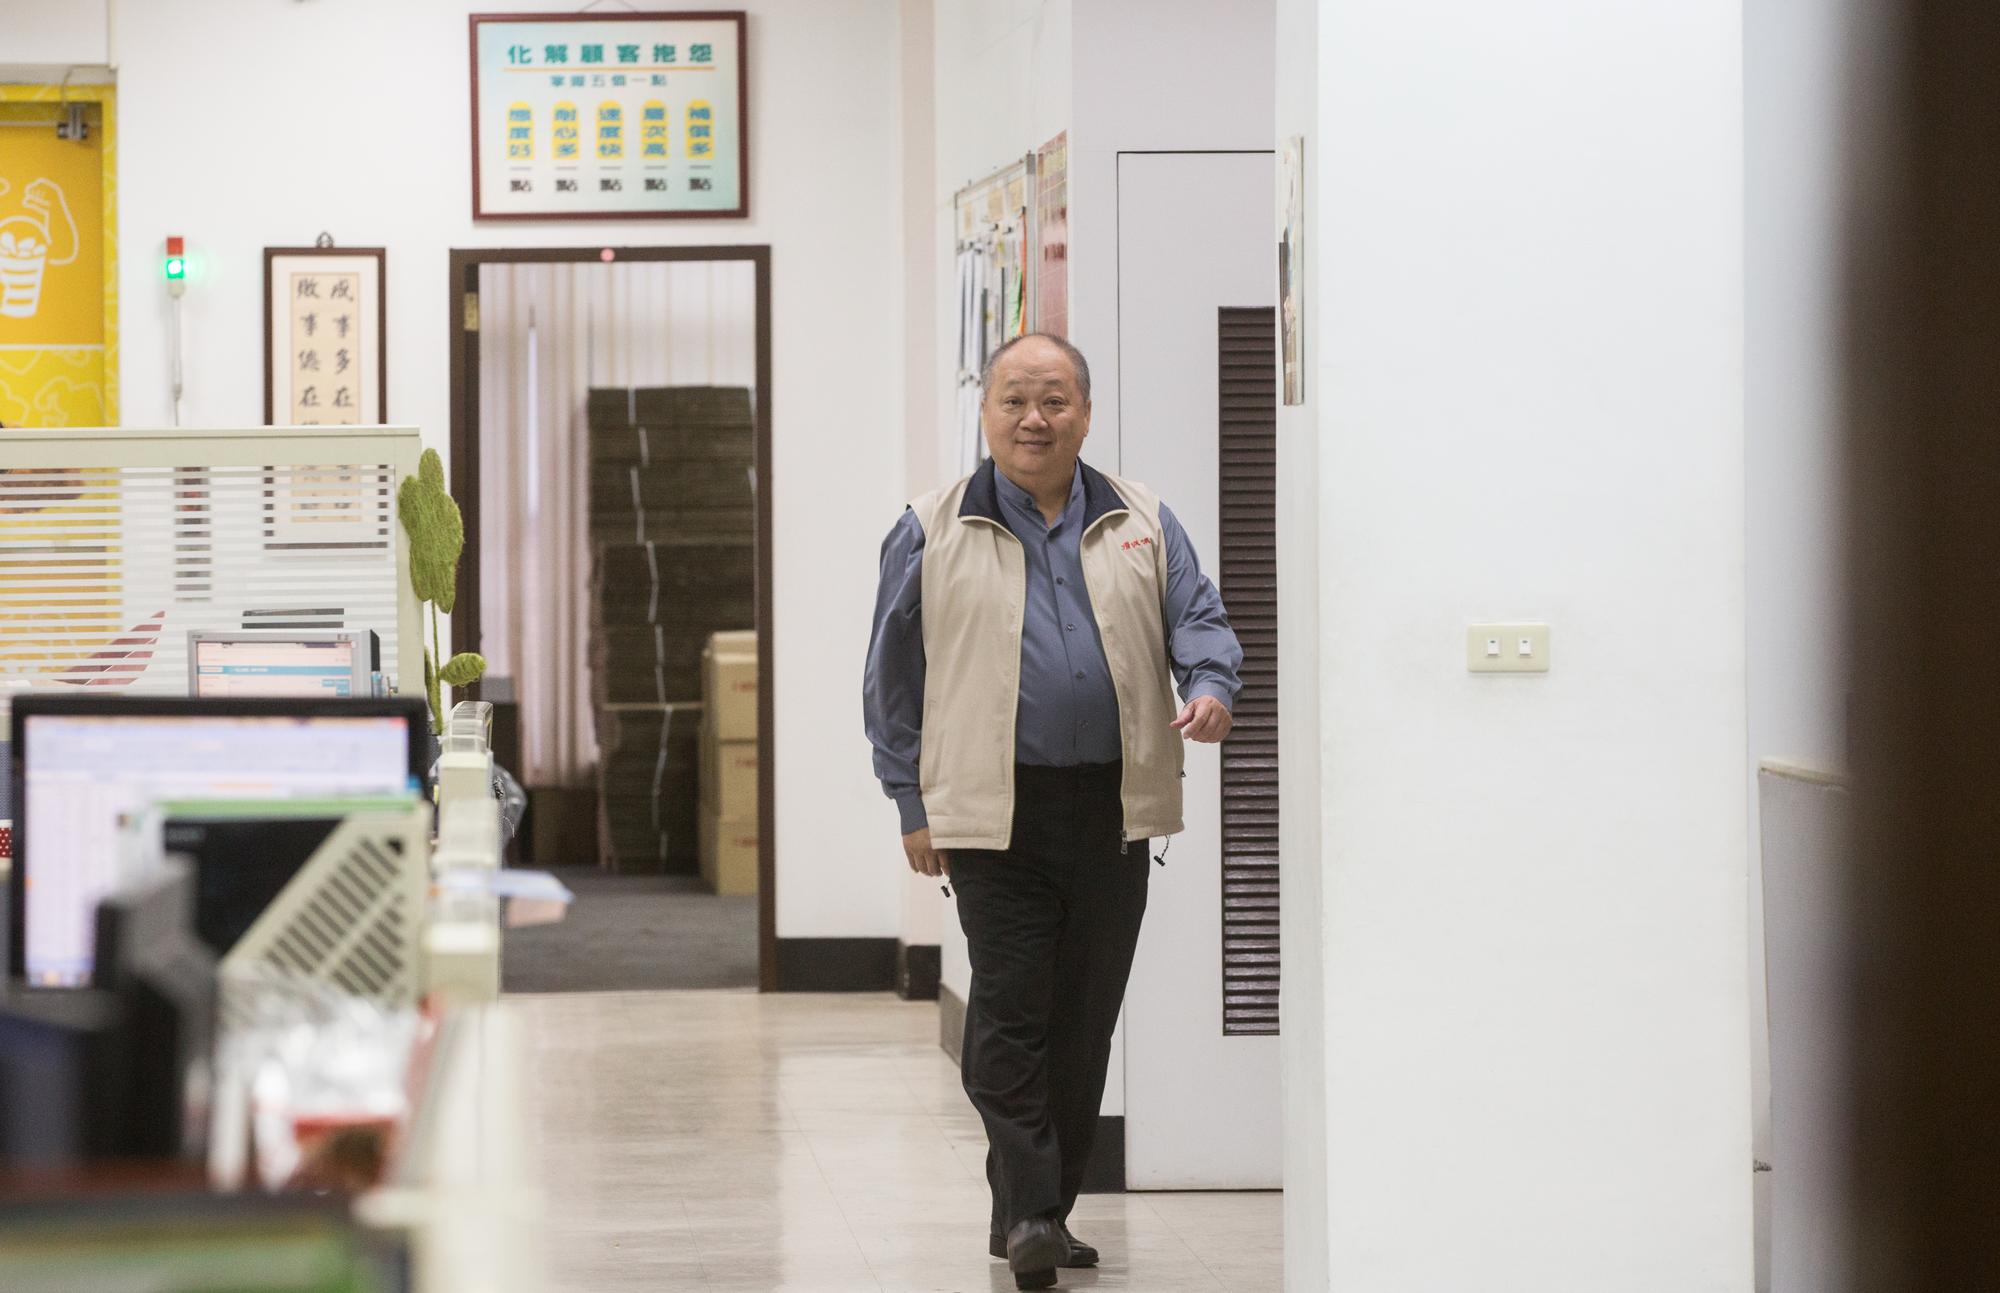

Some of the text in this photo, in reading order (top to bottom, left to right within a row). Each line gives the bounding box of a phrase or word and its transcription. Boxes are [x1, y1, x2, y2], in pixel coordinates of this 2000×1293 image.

[507, 44, 713, 64] 化解顧客抱怨
[331, 279, 354, 424] 成事多在
